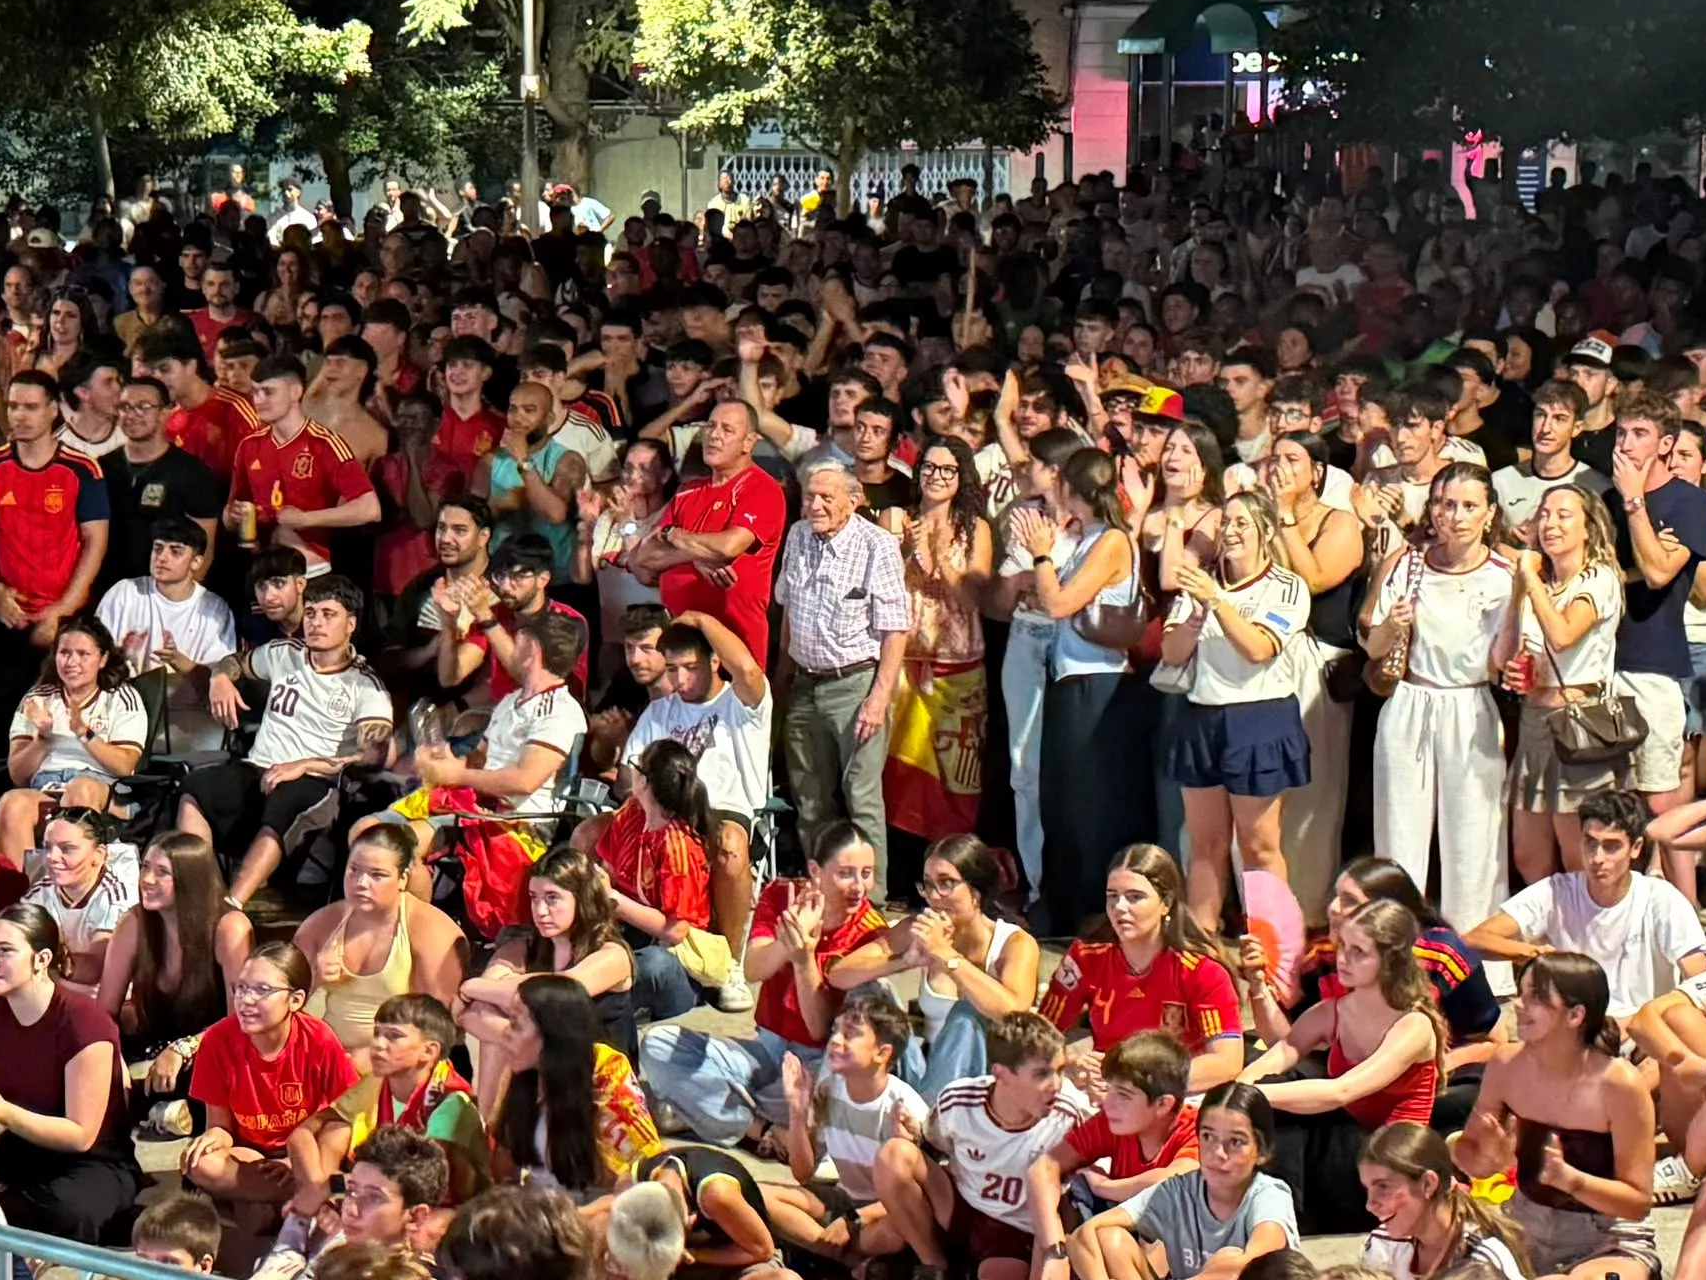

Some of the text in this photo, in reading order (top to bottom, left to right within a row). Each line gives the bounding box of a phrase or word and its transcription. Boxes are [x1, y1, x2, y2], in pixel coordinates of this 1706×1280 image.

[271, 479, 283, 509] 6
[270, 683, 300, 718] 20
[1093, 987, 1116, 1025] 4
[980, 1173, 1024, 1206] 20
